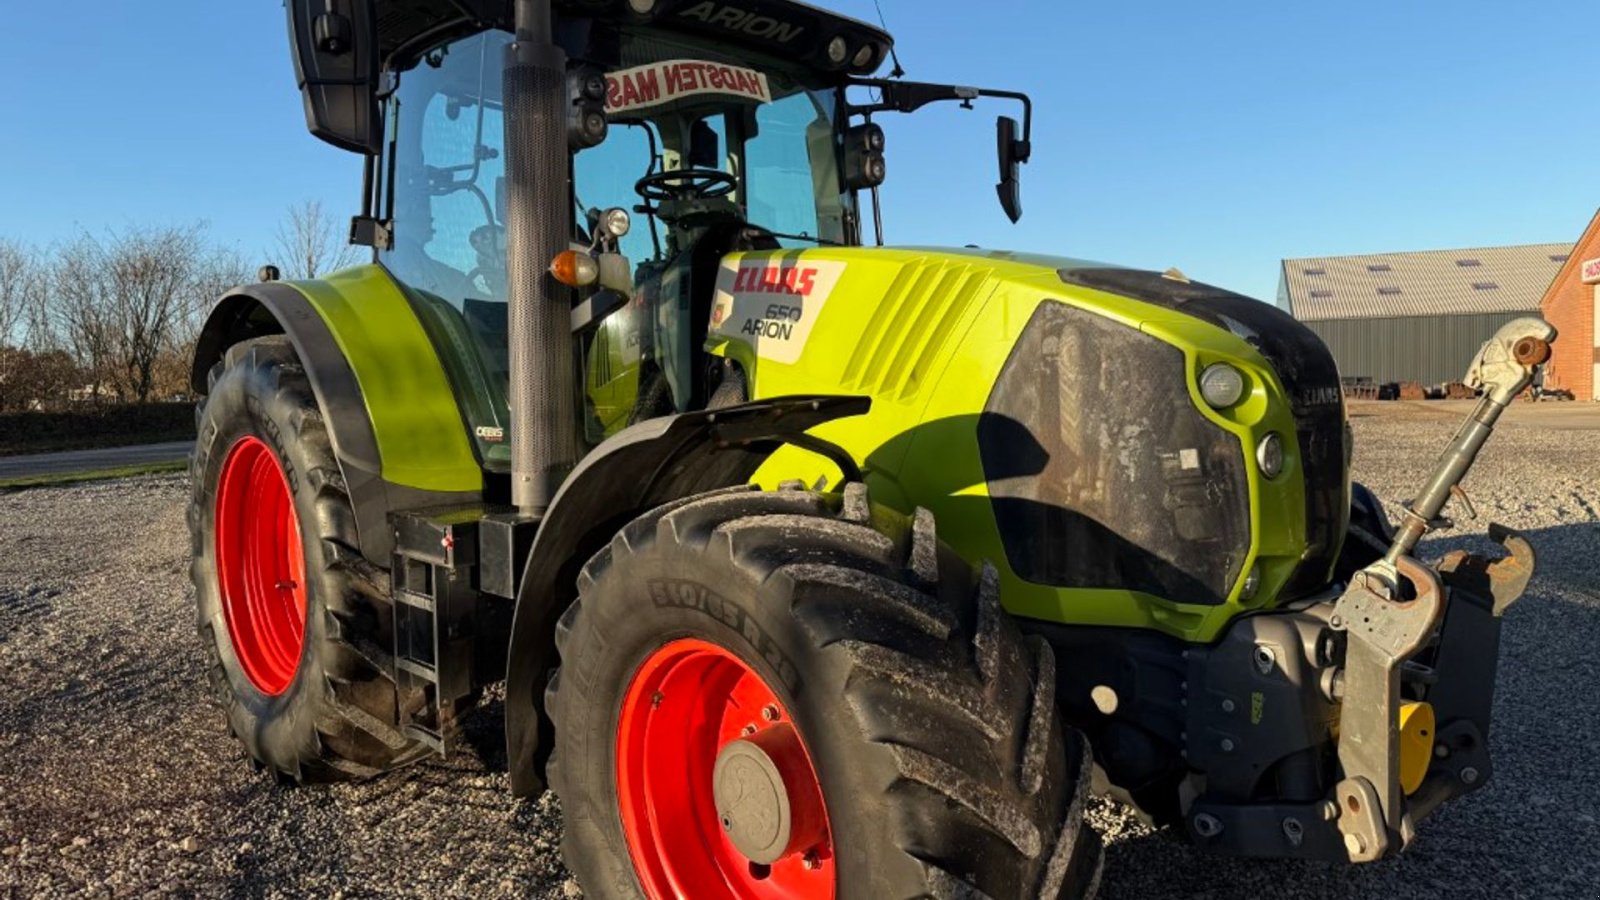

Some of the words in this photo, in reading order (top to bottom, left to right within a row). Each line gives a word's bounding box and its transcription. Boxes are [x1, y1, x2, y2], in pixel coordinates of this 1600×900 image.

[678, 1, 805, 42] ARION
[733, 266, 818, 296] CLAAS
[765, 303, 802, 322] 650
[741, 318, 793, 340] ARION
